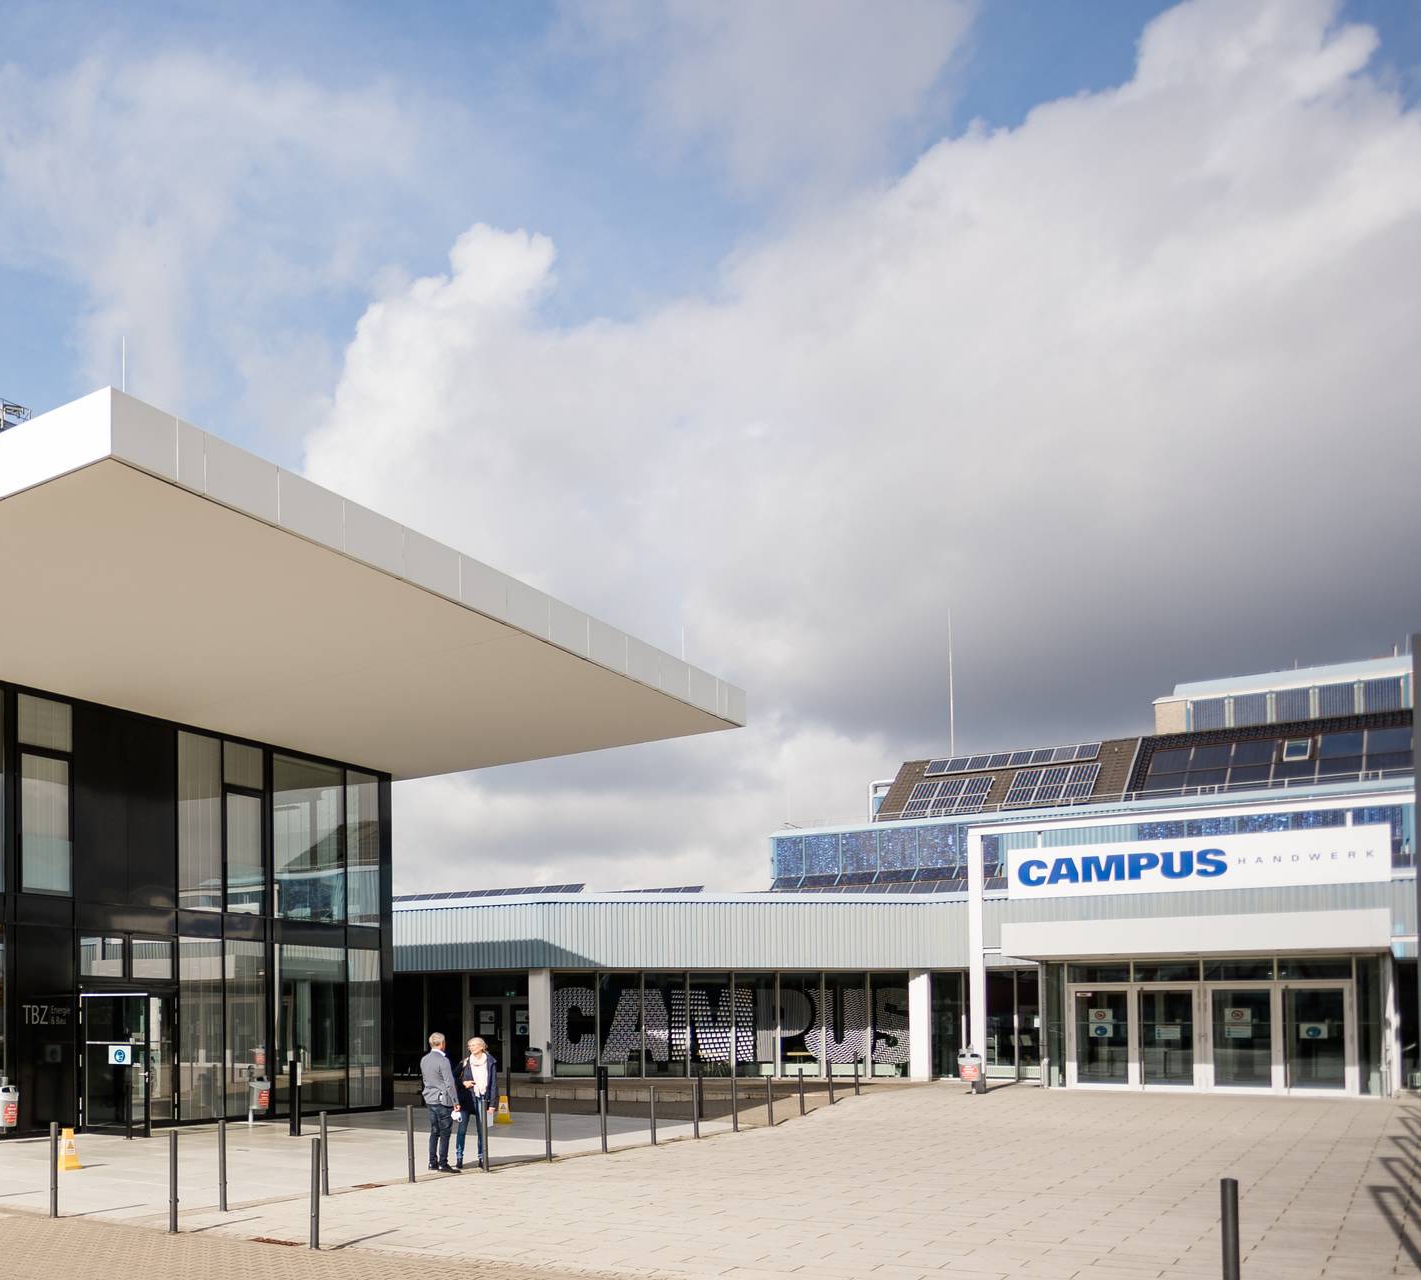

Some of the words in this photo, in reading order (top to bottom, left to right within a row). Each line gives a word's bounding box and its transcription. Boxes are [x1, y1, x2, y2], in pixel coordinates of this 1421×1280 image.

[1017, 848, 1228, 887] CAMPUS
[1237, 850, 1375, 865] HANDWERK
[22, 1005, 48, 1024] TBZ
[552, 986, 909, 1064] CAMPUS
